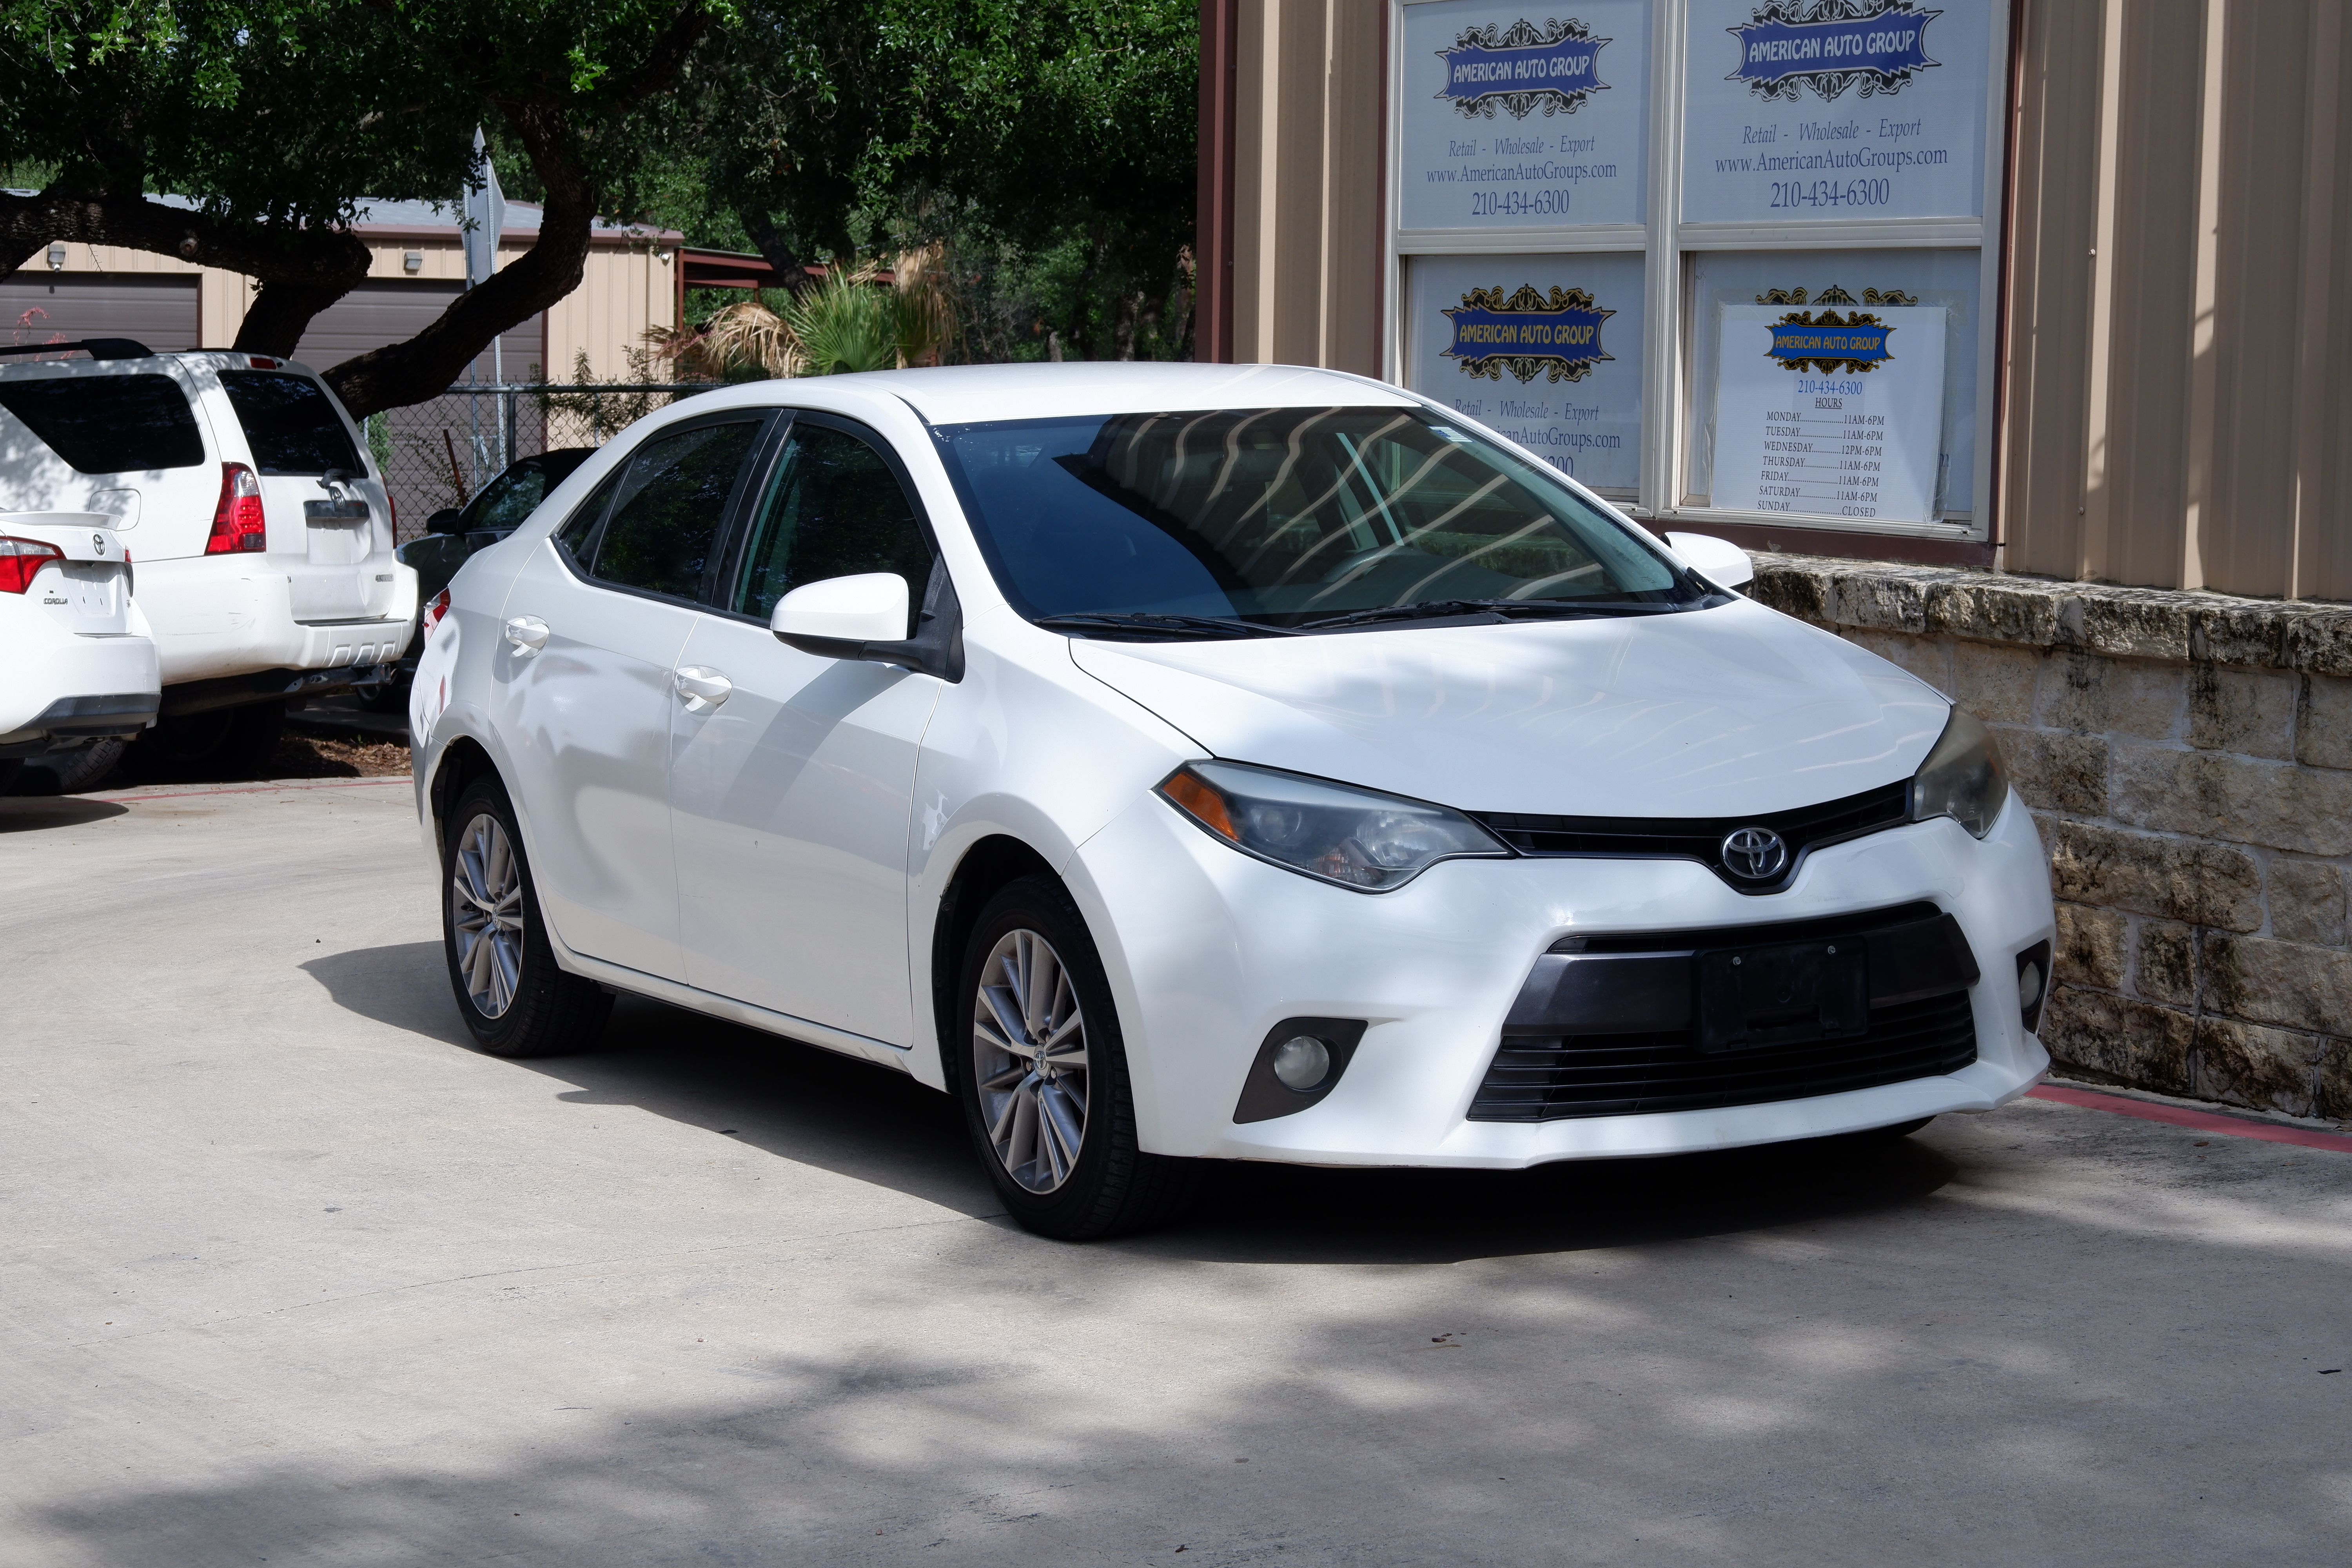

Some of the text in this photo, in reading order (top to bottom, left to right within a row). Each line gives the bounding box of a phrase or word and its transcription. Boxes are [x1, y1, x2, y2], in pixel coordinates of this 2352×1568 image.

[1749, 30, 1915, 62] AMERICAN AUTO GROUP
[1453, 56, 1590, 83] AMERICAN AUTO GROUP
[1742, 124, 1777, 144] Retail
[1799, 120, 1859, 142] Wholesale
[1879, 118, 1921, 143] Export
[1448, 139, 1477, 157] Retail
[1495, 137, 1544, 155] Wholesale
[1560, 135, 1595, 158] Export
[1715, 147, 1948, 172] www.AmericanAutoGroups.com
[1427, 161, 1617, 184] www.AmericanAutoGroups.com
[1472, 190, 1569, 215] 210-434-6300
[1770, 178, 1889, 207] 210-434-6300
[1459, 325, 1594, 345] AMERICAN AUTO GROUP
[1775, 335, 1881, 350] AMERICAN AUTO GROUP
[1798, 380, 1862, 395] 210-434-6300
[1455, 399, 1482, 416] Retail
[1500, 400, 1548, 419] Wholesale
[1564, 403, 1599, 426] Export
[1815, 397, 1842, 408] HOURS
